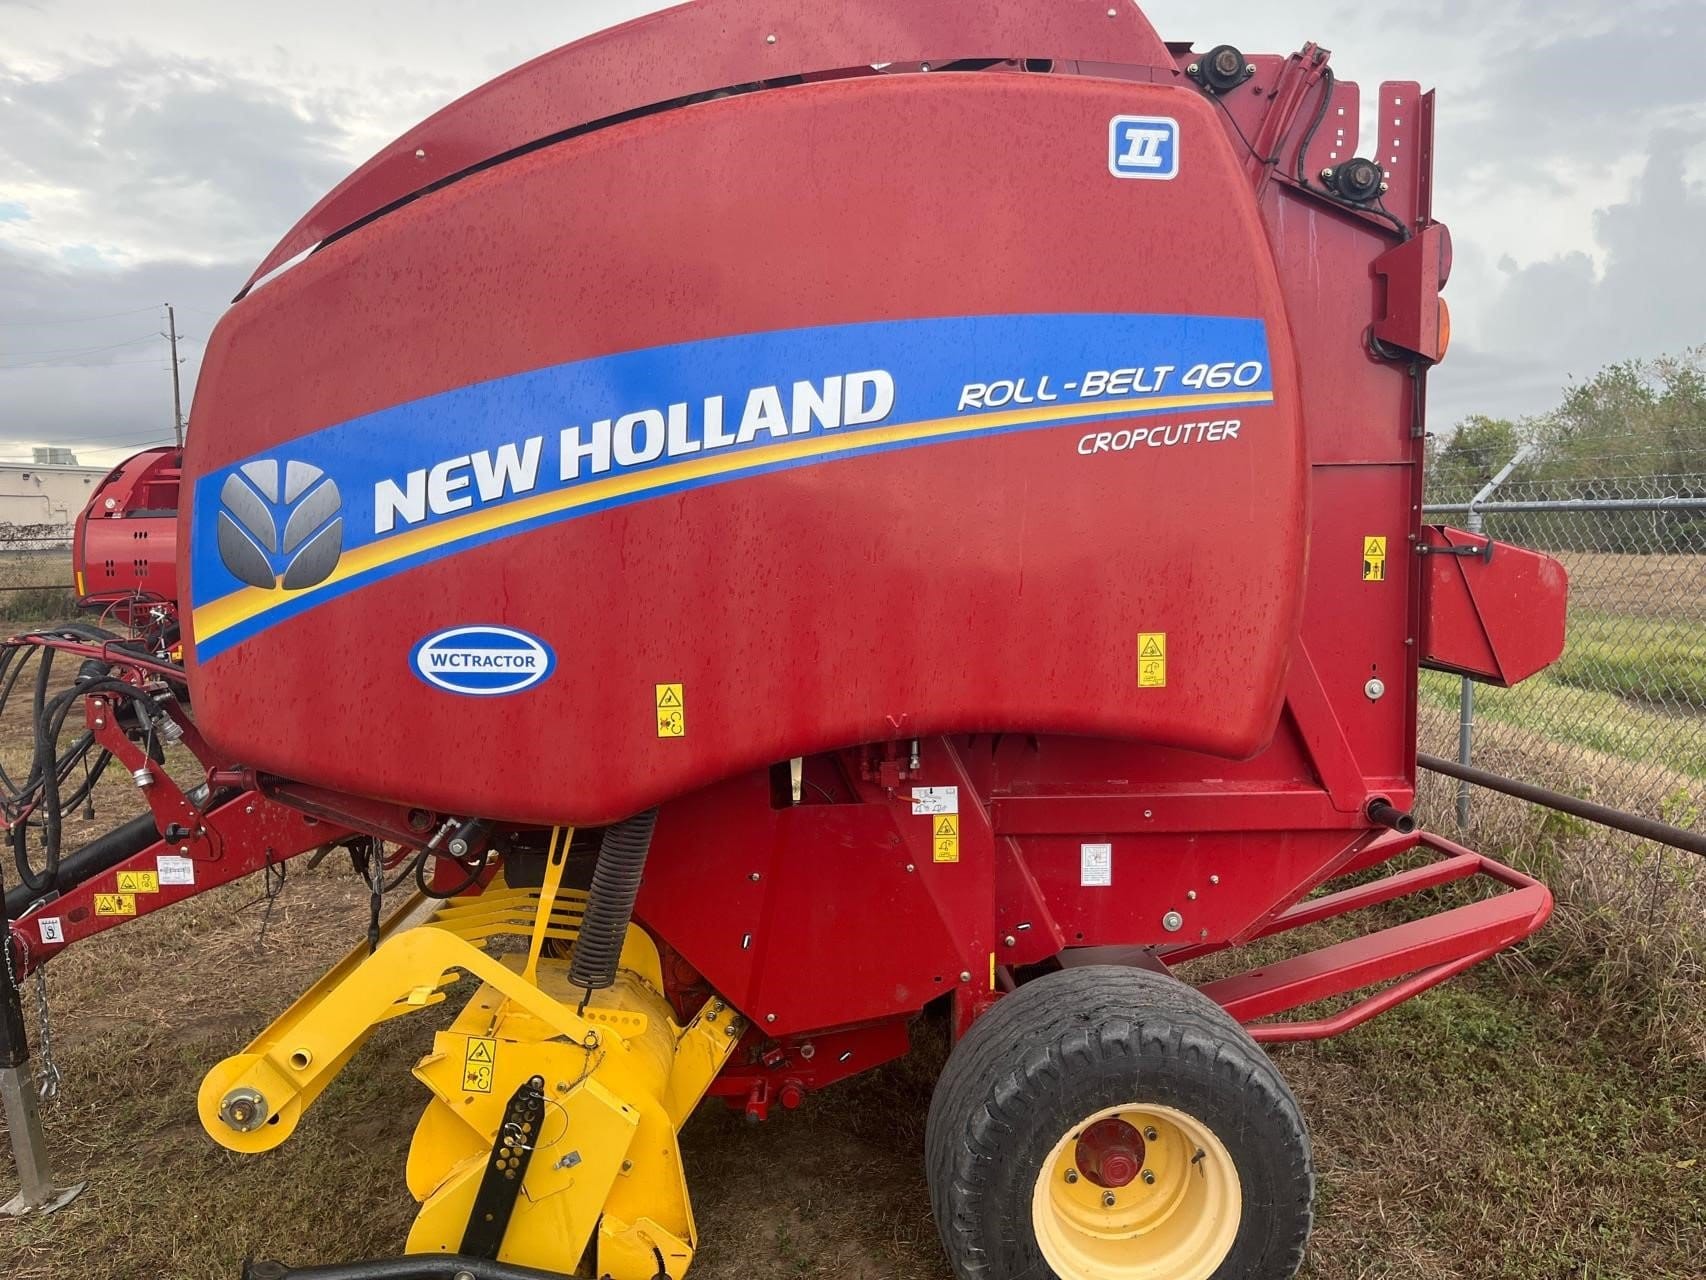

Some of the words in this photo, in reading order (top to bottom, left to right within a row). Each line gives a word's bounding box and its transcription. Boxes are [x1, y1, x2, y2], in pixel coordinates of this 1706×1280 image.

[1181, 361, 1263, 389] 460
[374, 436, 543, 534] NEW
[559, 369, 896, 482] HOLLAND
[1077, 419, 1241, 455] CROPCUTTER
